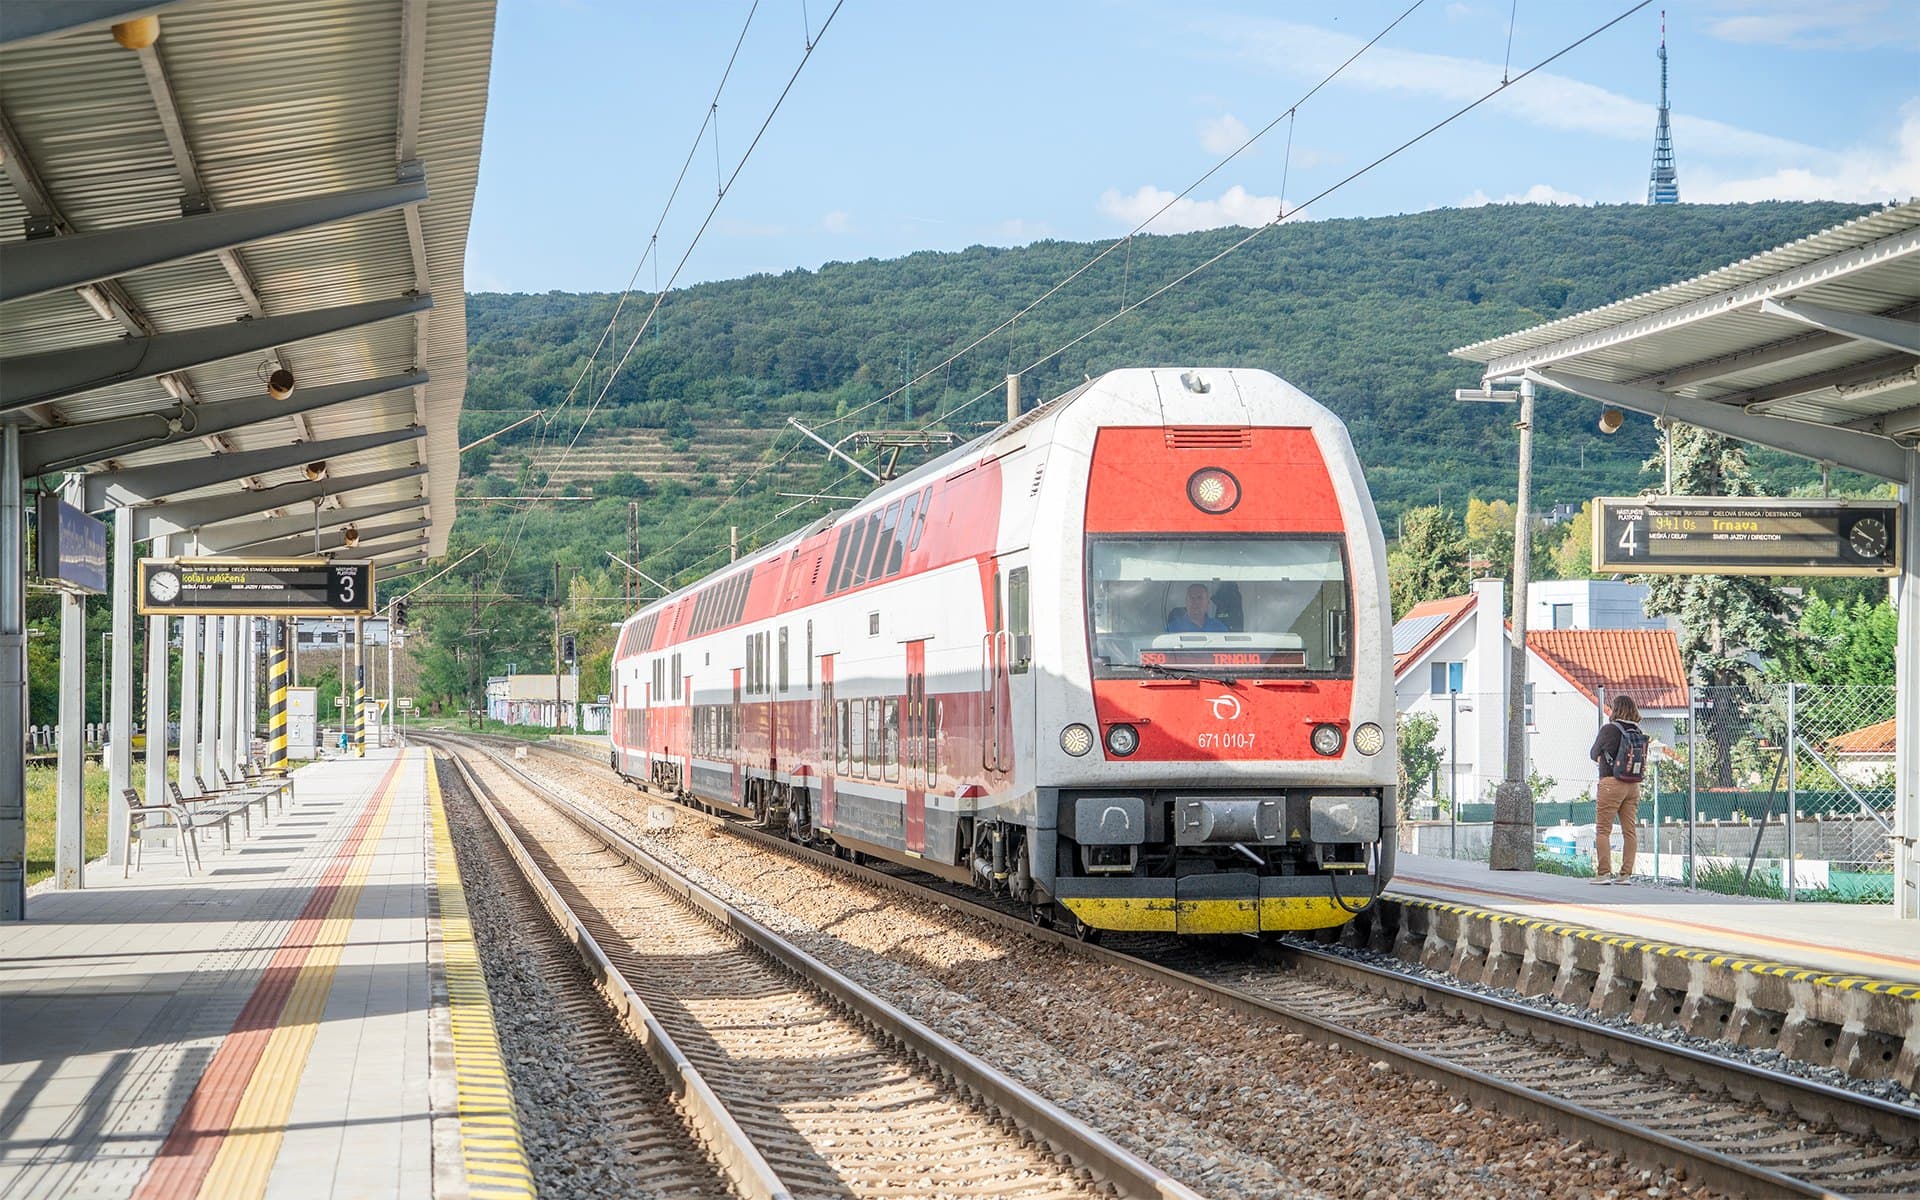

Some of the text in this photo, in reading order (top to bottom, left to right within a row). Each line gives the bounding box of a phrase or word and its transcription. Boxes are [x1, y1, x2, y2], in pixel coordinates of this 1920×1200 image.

[1712, 518, 1758, 531] Trnava
[1618, 521, 1637, 556] 4
[206, 572, 246, 584] vylúčená
[340, 576, 354, 602] 3
[1212, 653, 1261, 665] TRNAVA
[1198, 733, 1256, 748] 671 010-7
